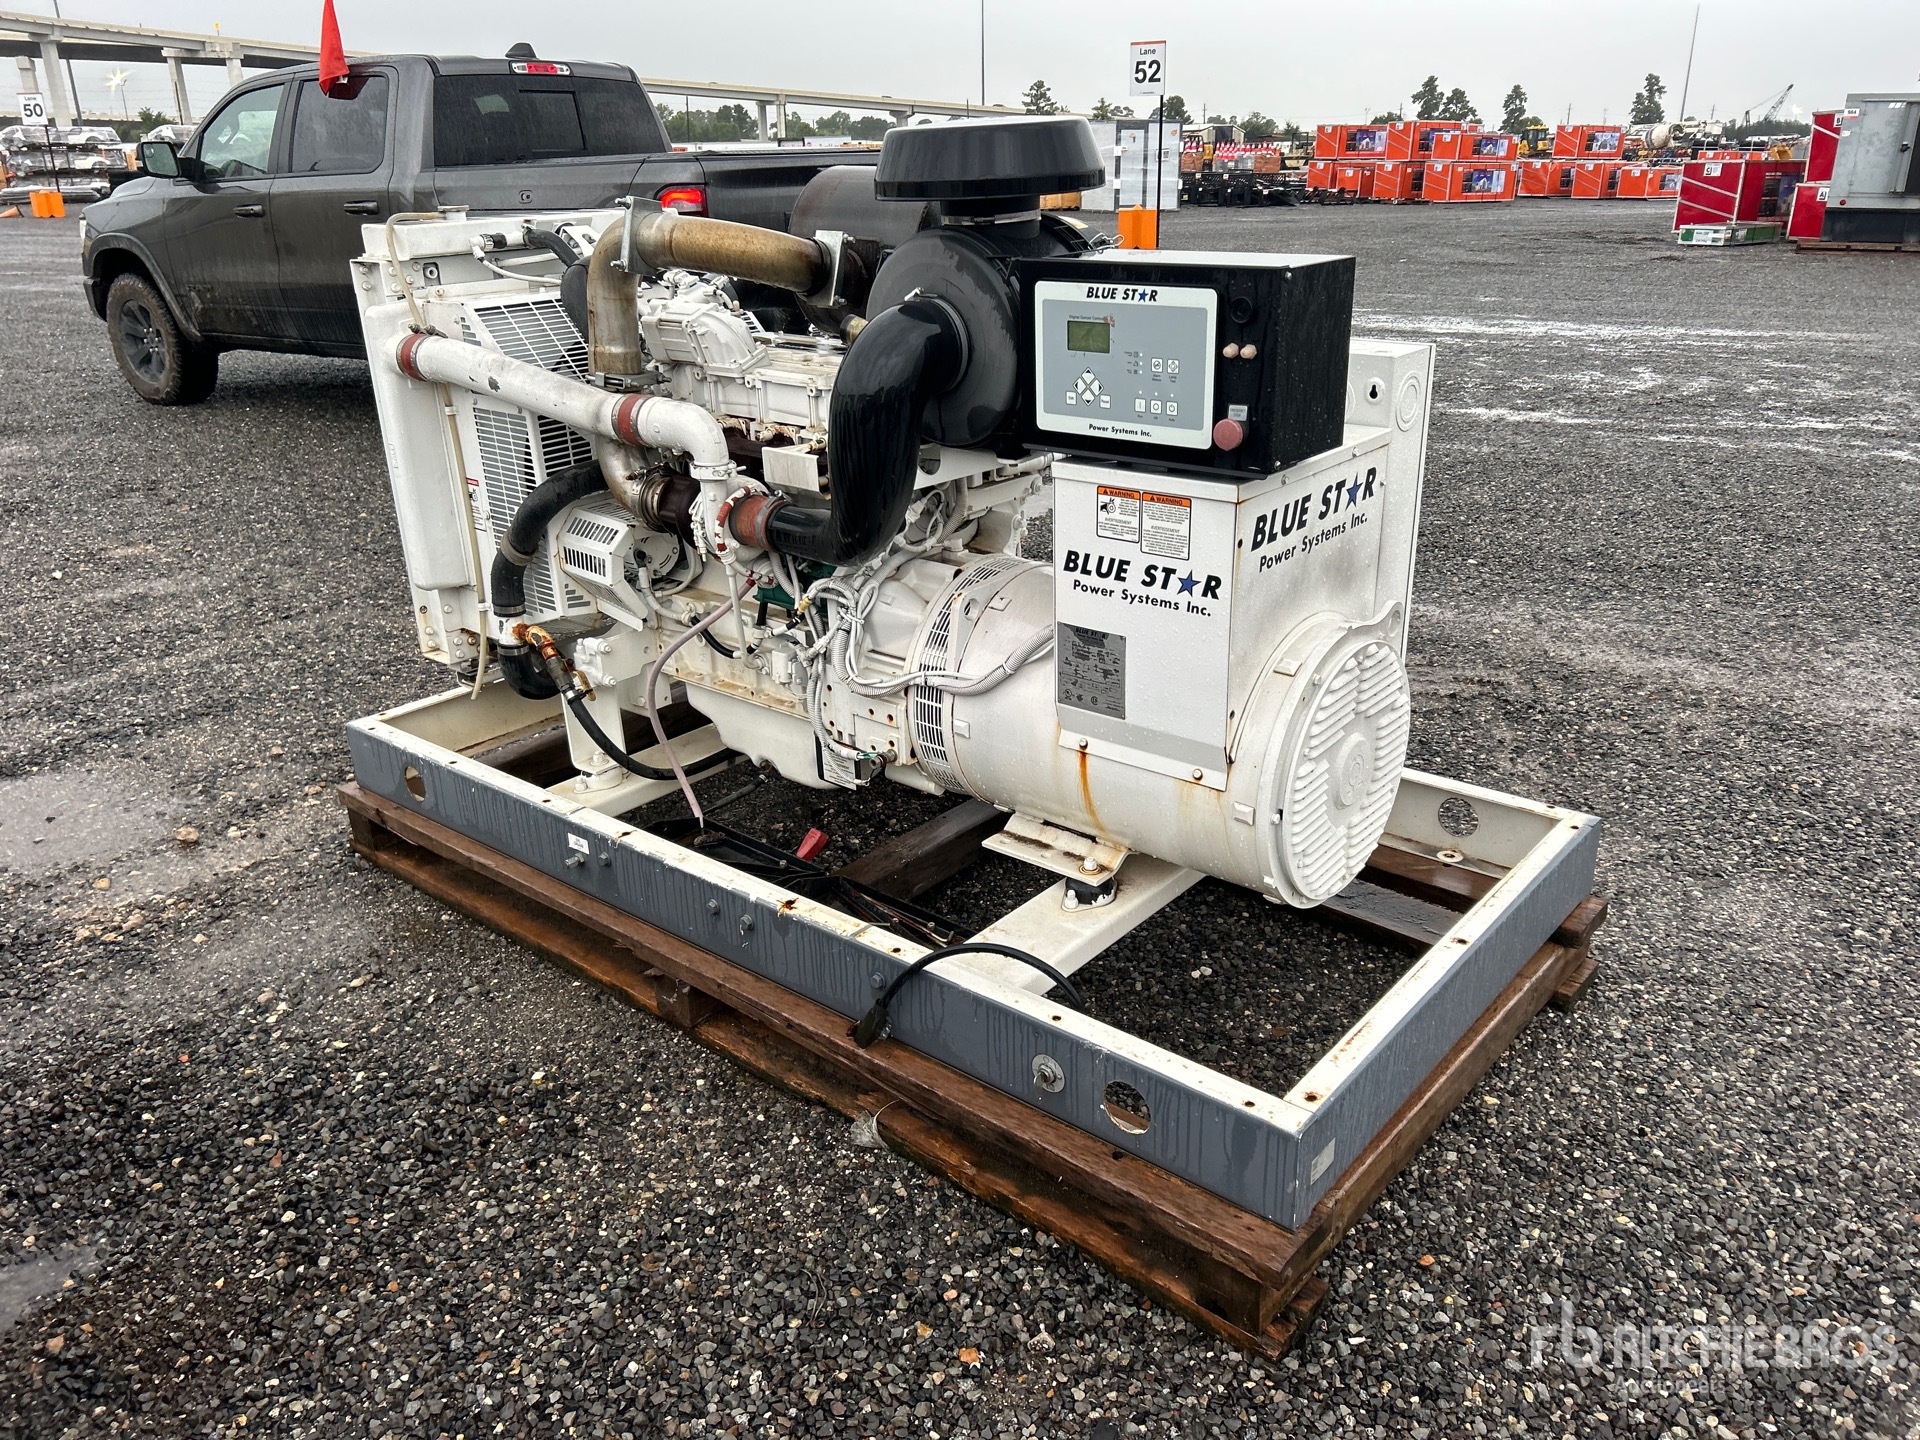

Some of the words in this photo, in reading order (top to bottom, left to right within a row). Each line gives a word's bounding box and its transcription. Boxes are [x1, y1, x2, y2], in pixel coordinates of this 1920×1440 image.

[1134, 59, 1161, 84] 52
[23, 103, 44, 117] 50
[1086, 286, 1118, 300] BLUE
[1088, 423, 1109, 432] Power
[1111, 426, 1138, 436] Systems
[1140, 429, 1152, 437] Inc.
[1109, 490, 1135, 498] WARNING
[1156, 497, 1183, 505] WARNING
[1250, 493, 1312, 552] BLUE
[1259, 545, 1296, 573] Power
[1301, 521, 1347, 554] Systems
[1350, 513, 1368, 529] Inc.
[1063, 549, 1132, 583] BLUE
[1073, 580, 1115, 598] Power
[1121, 589, 1180, 611] Systems
[1186, 601, 1212, 617] Inc.
